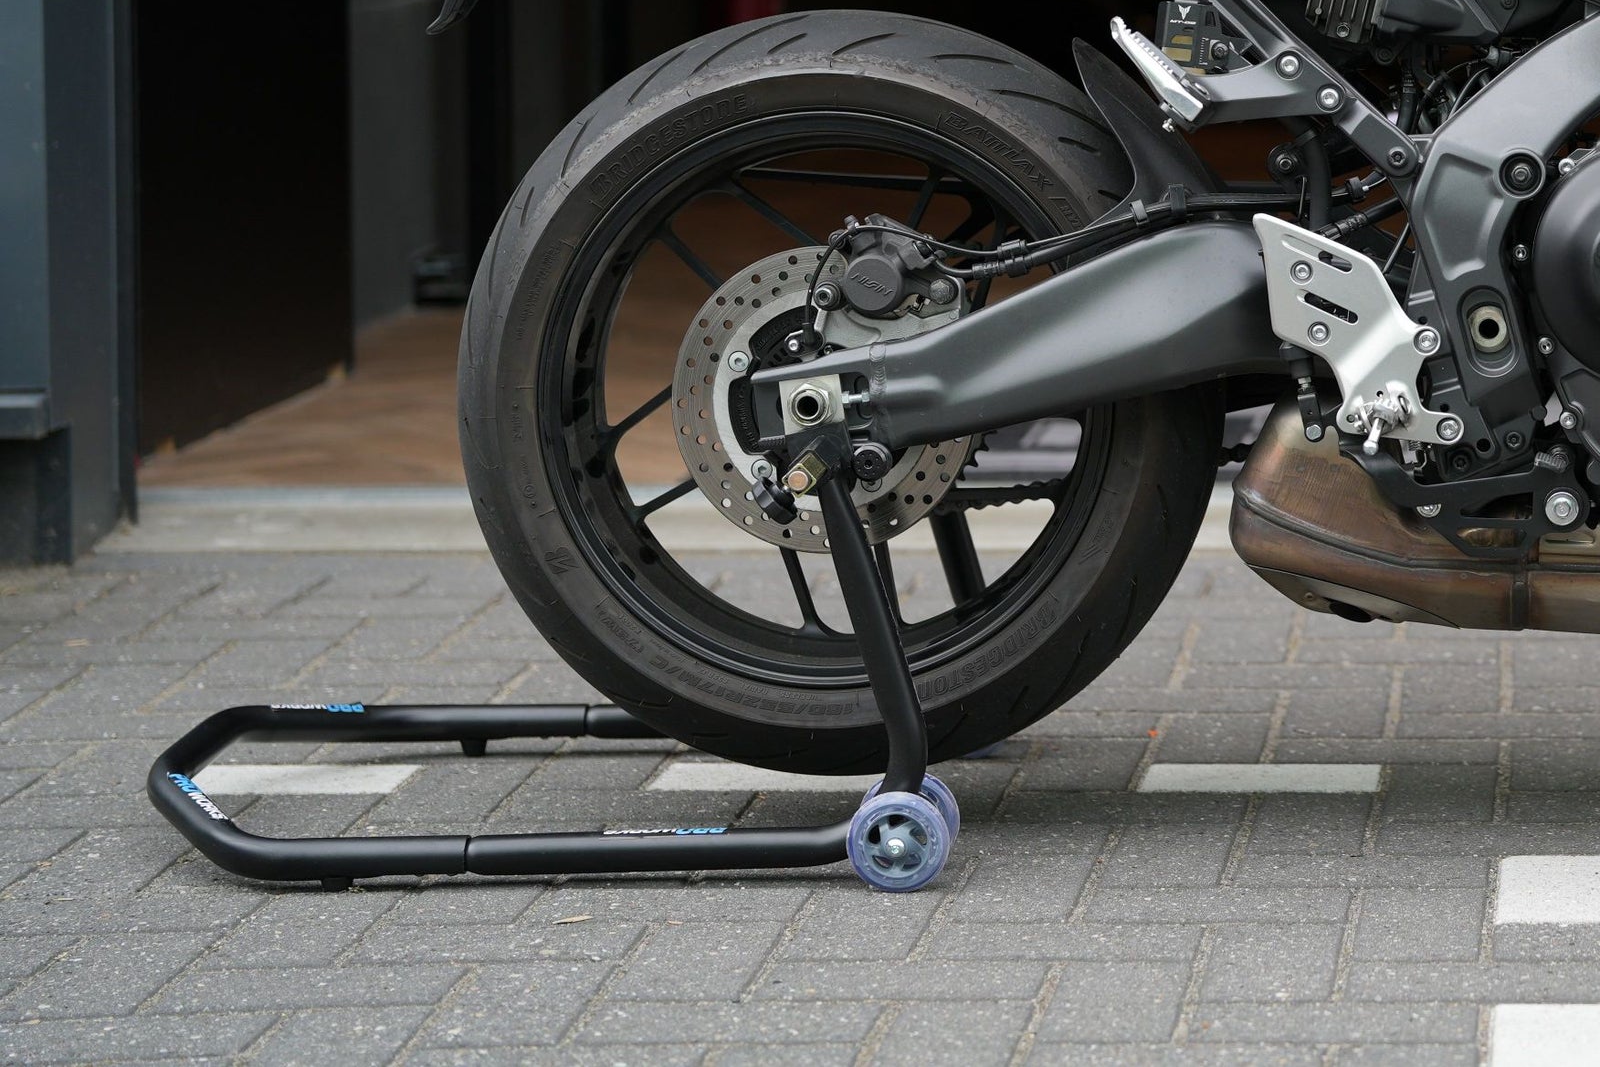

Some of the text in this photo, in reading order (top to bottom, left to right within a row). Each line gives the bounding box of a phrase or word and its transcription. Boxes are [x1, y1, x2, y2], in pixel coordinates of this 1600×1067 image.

[592, 94, 747, 199] BRIDGESTONE
[944, 110, 1054, 194] BATTLAX
[916, 605, 1058, 702] BRIDGESTON
